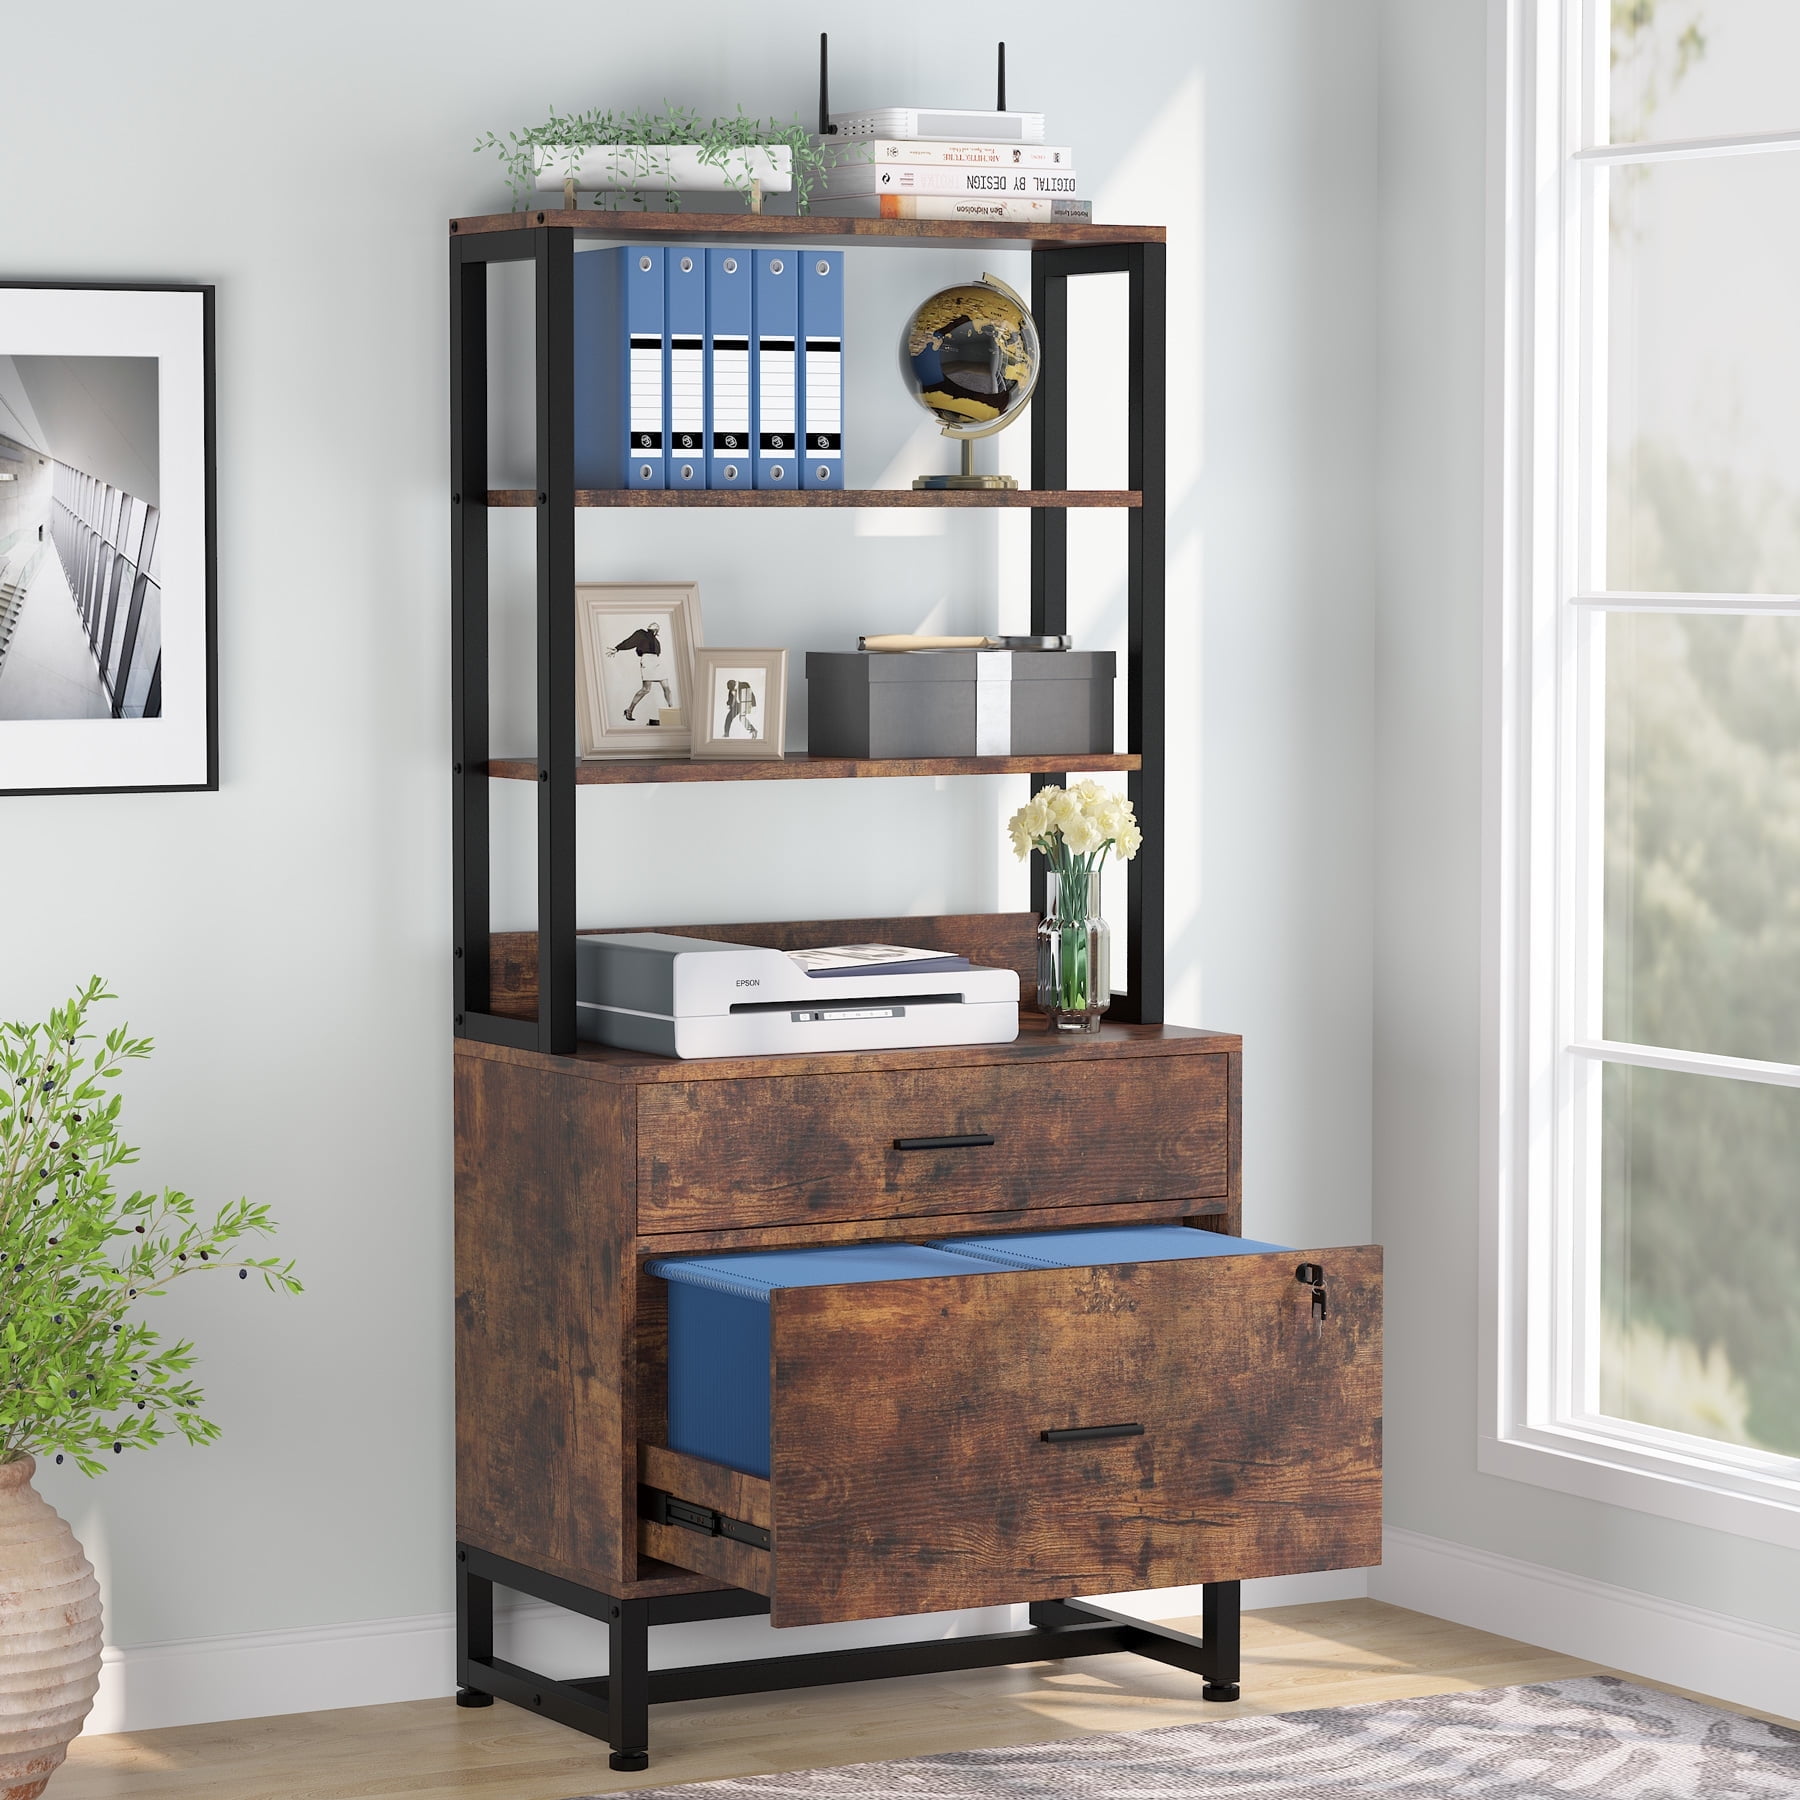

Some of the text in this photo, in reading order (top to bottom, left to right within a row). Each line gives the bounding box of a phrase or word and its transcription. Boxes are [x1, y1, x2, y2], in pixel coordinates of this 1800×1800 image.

[943, 153, 1001, 162] ARCHITECTURE
[966, 175, 1007, 190] DESIGN
[1013, 176, 1026, 191] BY
[1033, 177, 1076, 192] DIGITAL
[956, 206, 1003, 216] Ben Nicholson
[736, 979, 760, 987] EPSON
